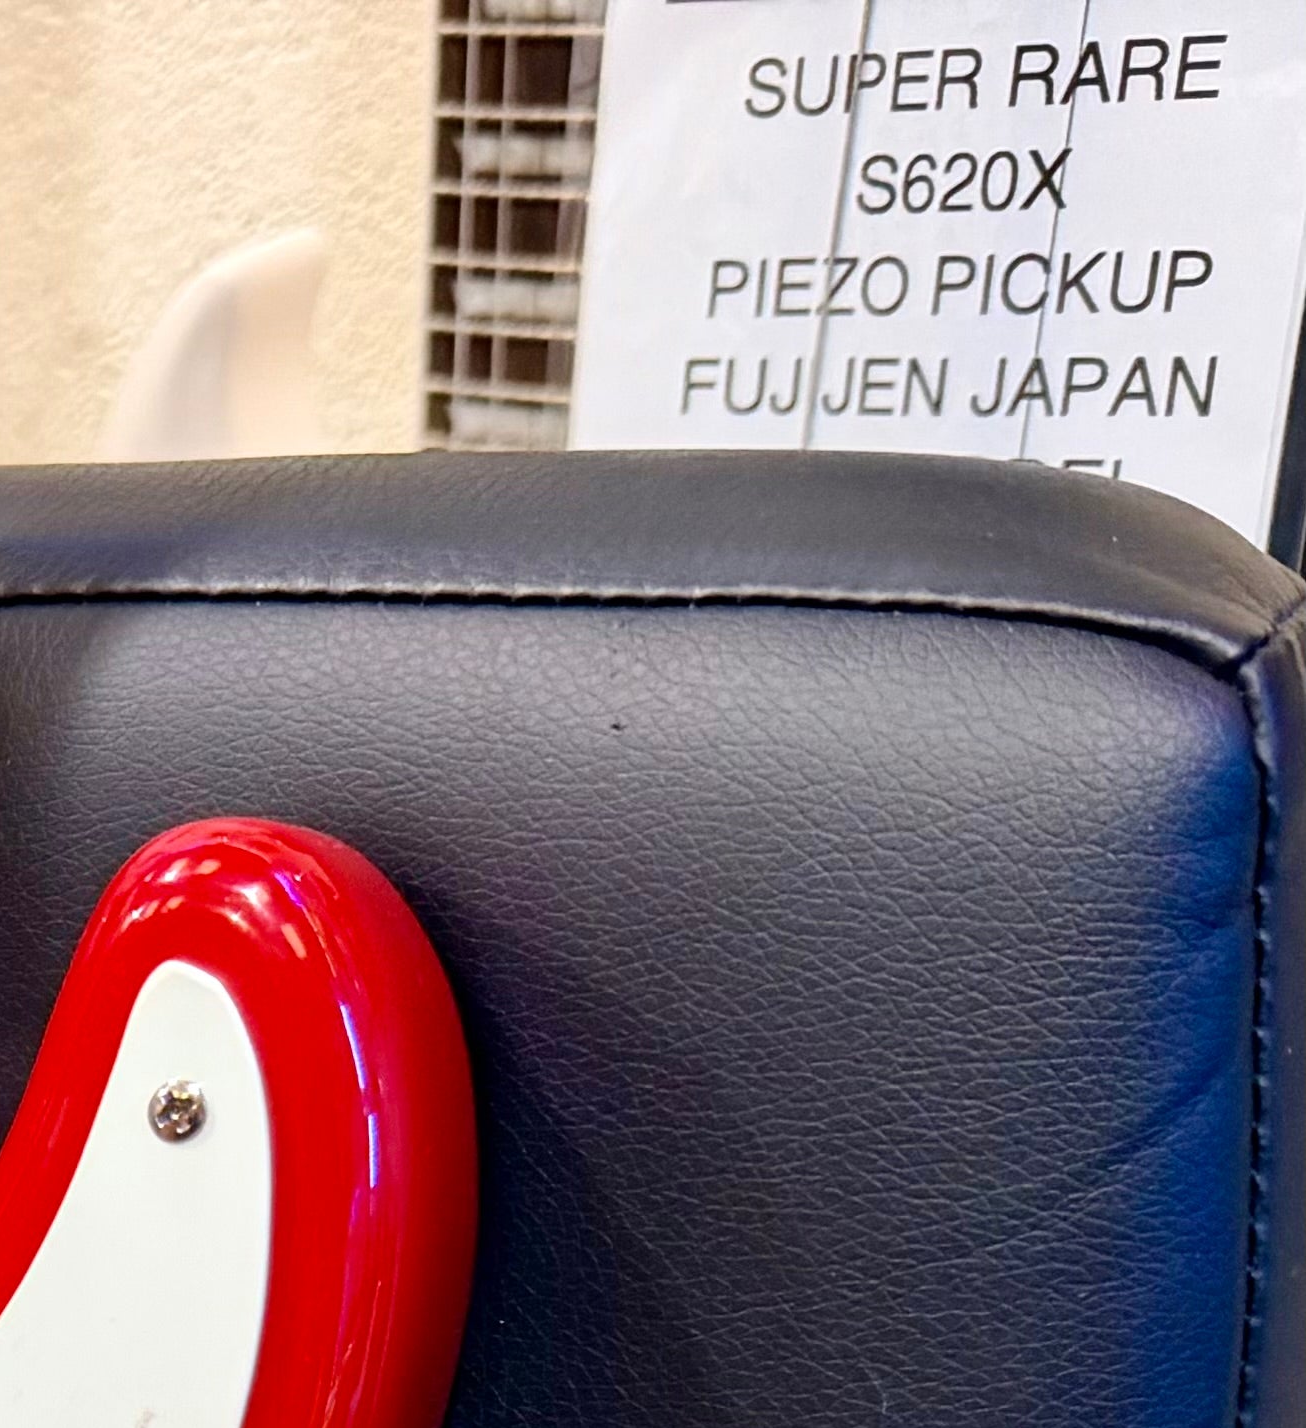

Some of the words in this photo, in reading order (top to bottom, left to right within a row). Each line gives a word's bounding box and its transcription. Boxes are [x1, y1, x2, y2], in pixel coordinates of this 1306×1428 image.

[744, 48, 985, 119] SUPER
[1007, 33, 1229, 108] RARE
[856, 147, 1073, 215] S620X
[707, 254, 910, 318] PIEZO
[930, 249, 1214, 317] PICKUP
[680, 357, 949, 417] FUJJEN
[970, 354, 1219, 419] JAPAN
